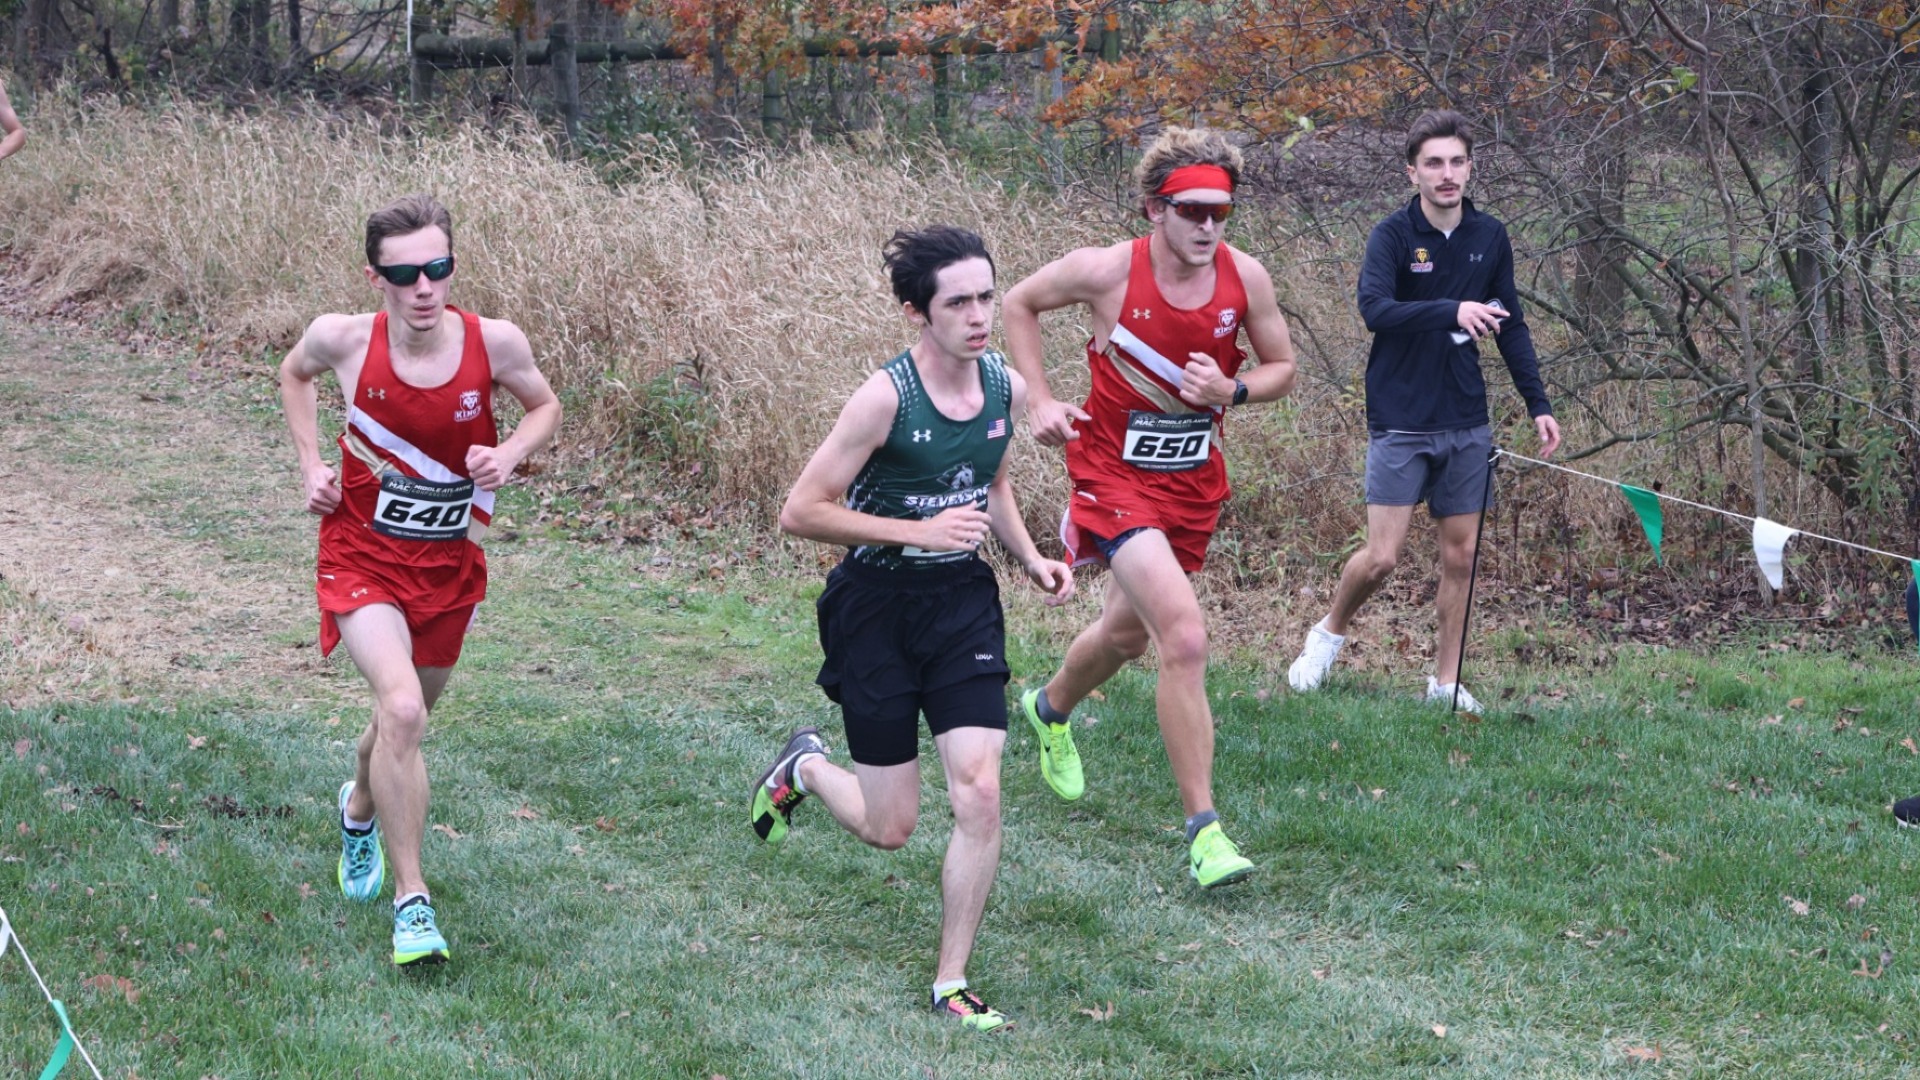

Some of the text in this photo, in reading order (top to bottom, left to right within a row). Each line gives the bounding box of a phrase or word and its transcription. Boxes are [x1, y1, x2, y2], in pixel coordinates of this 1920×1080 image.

[1134, 418, 1155, 427] MAC
[1157, 417, 1210, 426] MIDDLE ATLANTIC
[1131, 434, 1206, 459] 650
[388, 481, 411, 492] MAC
[414, 483, 472, 494] MIDDLE ATLANTIC
[381, 499, 469, 527] 640
